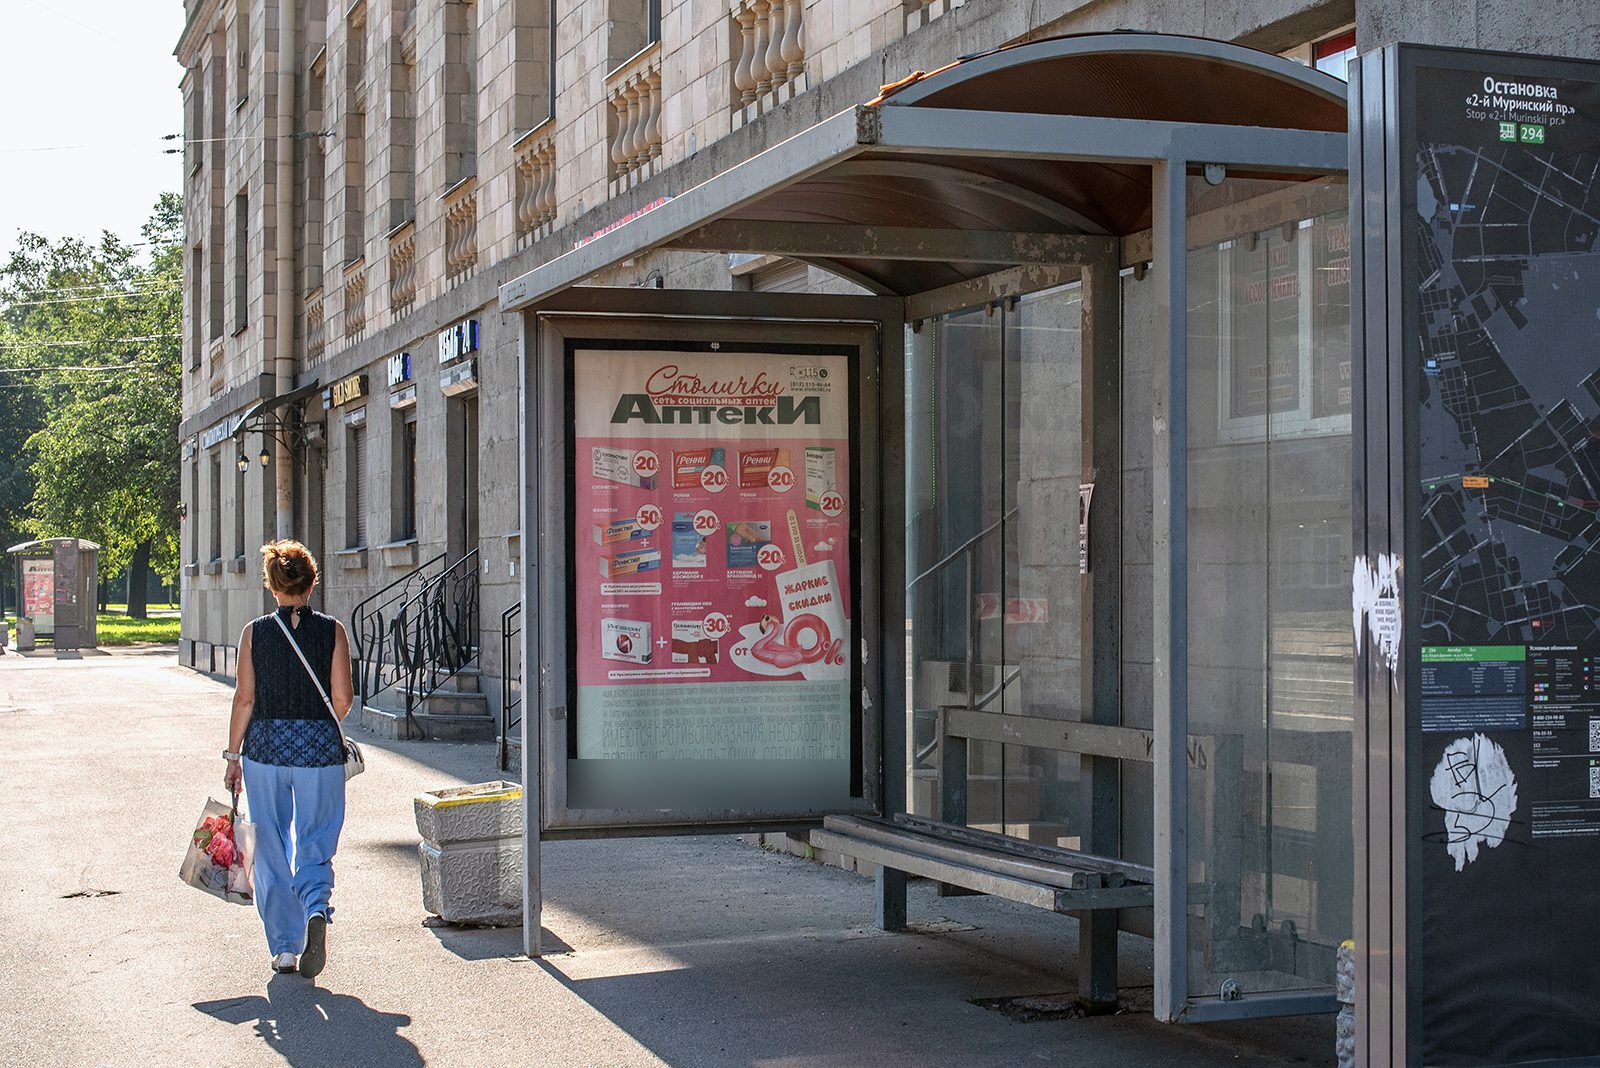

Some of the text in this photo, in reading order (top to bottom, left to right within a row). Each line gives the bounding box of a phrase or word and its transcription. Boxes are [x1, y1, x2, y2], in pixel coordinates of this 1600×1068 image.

[1483, 76, 1558, 99] Остановка
[1465, 94, 1576, 117] «2-й Муринский пр.»
[1466, 108, 1487, 122] Stop
[1509, 111, 1547, 125] Murinskii
[1521, 127, 1544, 141] 294
[645, 365, 785, 396] Столички
[654, 397, 676, 405] сеть
[678, 397, 743, 407] социальных
[784, 575, 829, 595] ЖАРКИЕ
[788, 593, 832, 611] СКИДКИ
[603, 726, 651, 748] ИМЕЮТСЯ
[769, 720, 842, 744] НЕОБХОДИМО
